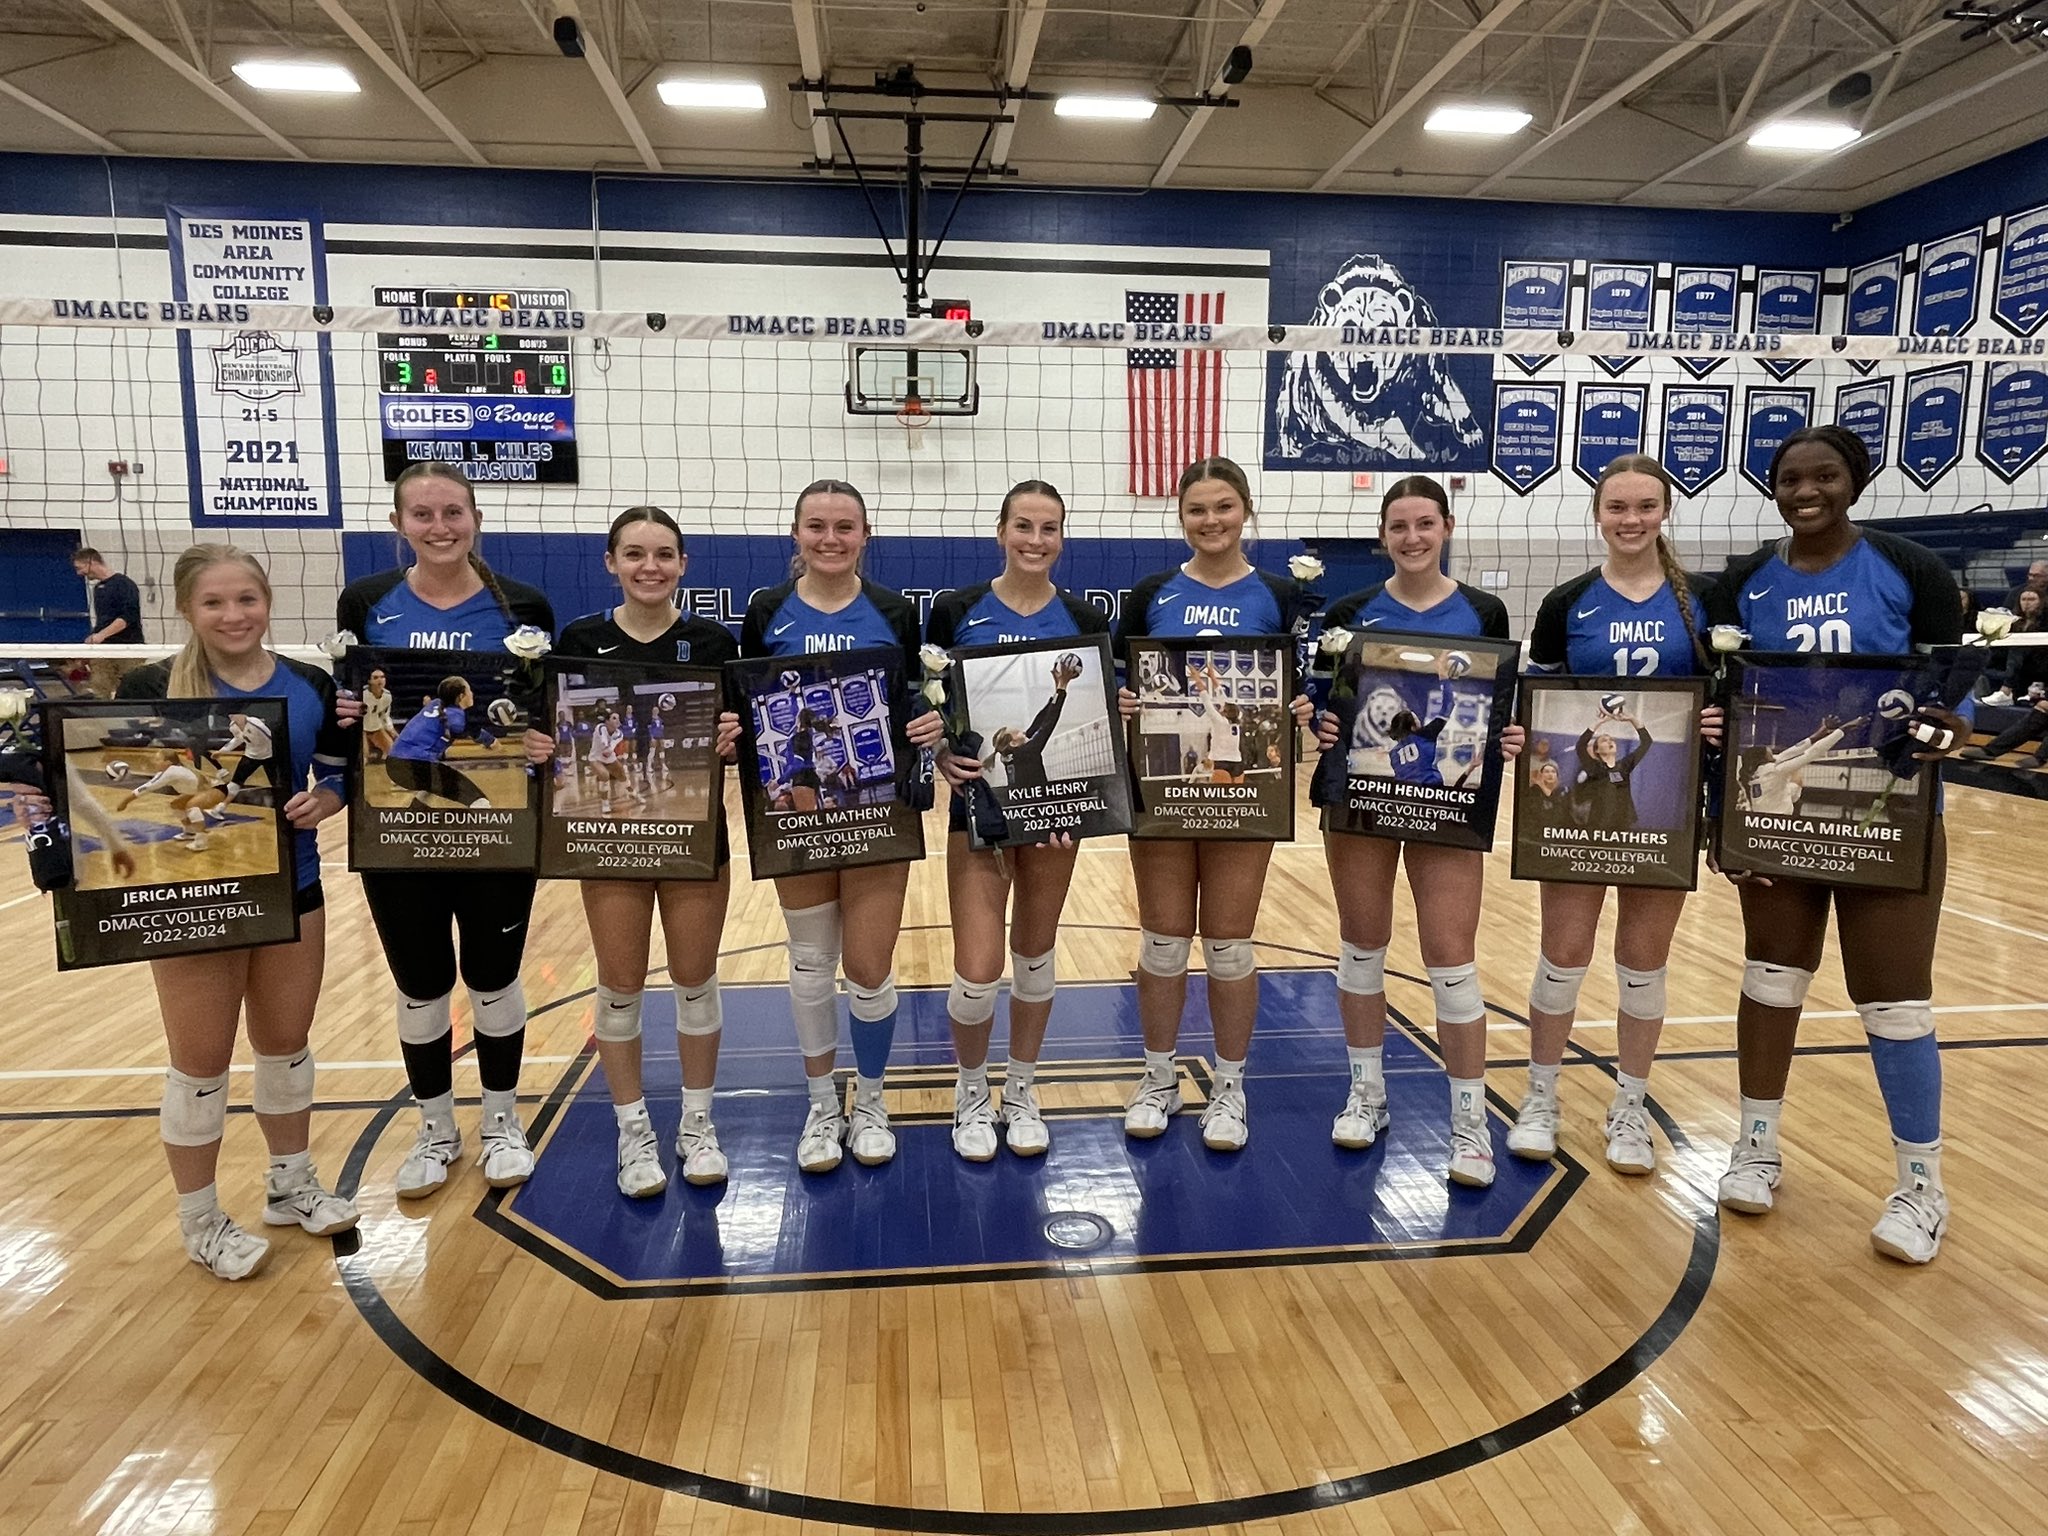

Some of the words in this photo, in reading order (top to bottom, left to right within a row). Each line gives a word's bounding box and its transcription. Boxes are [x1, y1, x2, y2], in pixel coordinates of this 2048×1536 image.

[188, 224, 223, 238] DES
[232, 225, 303, 241] MOINES
[223, 245, 273, 260] AREA
[192, 264, 305, 281] COMMUNITY
[212, 285, 289, 300] COLLEGE
[382, 291, 416, 304] HOME
[521, 294, 565, 306] VISITOR
[54, 299, 149, 320] DMACC
[160, 302, 249, 324] BEARS
[399, 308, 489, 328] DMACC
[500, 310, 585, 330] BEARS
[728, 314, 815, 336] DMACC
[825, 317, 907, 337] BEARS
[1042, 322, 1125, 341] DMACC
[1134, 324, 1213, 342] BEARS
[398, 337, 428, 347] BONUS
[520, 339, 547, 348] BONUS
[1342, 328, 1420, 346] DMACC
[1430, 329, 1504, 347] BEARS
[1628, 333, 1702, 350] DMACC
[1710, 334, 1782, 351] BEARS
[1898, 337, 1969, 354] DMACC
[1976, 338, 2045, 356] BEARS
[384, 352, 411, 362] FOULS
[444, 353, 476, 362] PLAYER
[484, 354, 511, 363] FOULS
[539, 355, 566, 364] FOULS
[222, 369, 293, 382] CHAMPIONSHIP
[398, 362, 412, 384] 3
[242, 408, 278, 421] 21-5
[392, 408, 466, 423] ROLFES
[474, 405, 492, 422] @
[493, 404, 555, 424] Boone
[1517, 408, 1538, 418] 2014
[1601, 410, 1622, 419] 2014
[1686, 412, 1706, 420] 2014
[1768, 414, 1788, 422] 2014
[227, 440, 298, 463] 2021
[406, 442, 464, 460] KEVIN
[471, 442, 488, 460] L.
[495, 443, 552, 462] MILES
[450, 462, 536, 480] MNASIUM
[220, 478, 309, 491] NATIONAL
[213, 496, 318, 510] CHAMPIONS
[1787, 592, 1848, 621] DMACC
[1183, 605, 1240, 628] DMACC
[1610, 620, 1665, 644] DMACC
[676, 640, 691, 662] D
[1613, 646, 1660, 676] 12
[1008, 786, 1042, 800] KYLIE
[1046, 781, 1088, 796] HENRY
[1164, 787, 1200, 798] EDEN
[1203, 787, 1258, 798] WILSON
[1348, 778, 1390, 794] ZOPHI
[1395, 784, 1476, 804] HENDRICKS
[380, 812, 440, 824] MADDIE
[444, 812, 512, 824] DUNHAM
[778, 814, 822, 830] CORYL
[826, 806, 892, 824] MATHENY
[1002, 807, 1036, 820] MACC
[1038, 800, 1108, 816] VOLLEYBALL
[1154, 806, 1196, 816] DMACC
[1198, 806, 1268, 817] VOLLEYBALL
[1350, 798, 1394, 814] DMACC
[1396, 804, 1468, 823] VOLLEYBALL
[567, 822, 618, 834] KENYA
[622, 823, 694, 836] PRESCOTT
[1024, 815, 1082, 832] 2022-2024
[1182, 818, 1240, 829] 2022-2024
[1376, 814, 1436, 832] 2022-2024
[1744, 816, 1814, 834] MONICA
[380, 833, 429, 844] DMACC
[432, 834, 512, 844] VOLLEYBALL
[777, 835, 822, 850] DMACC
[824, 826, 896, 844] VOLLEYBALL
[1544, 827, 1590, 841] EMMA
[1594, 830, 1668, 845] FLATHERS
[413, 847, 480, 858] 2022-2024
[566, 842, 614, 854] DMACC
[616, 844, 692, 856] VOLLEYBALL
[808, 842, 868, 860] 2022-2024
[1540, 846, 1586, 860] DMACC
[1589, 850, 1668, 864] VOLLEYBALL
[1748, 838, 1800, 853] DMACC
[1803, 843, 1894, 862] VOLLEYBALL
[596, 856, 661, 868] 2022-2024
[1570, 861, 1634, 874] 2022-2024
[1781, 855, 1856, 872] 2022-2024
[122, 888, 178, 908] JERICA
[182, 882, 240, 899] HEINTZ
[98, 914, 162, 933] DMACC
[166, 904, 264, 926] VOLLEYBALL
[142, 924, 226, 944] 2022-2024
